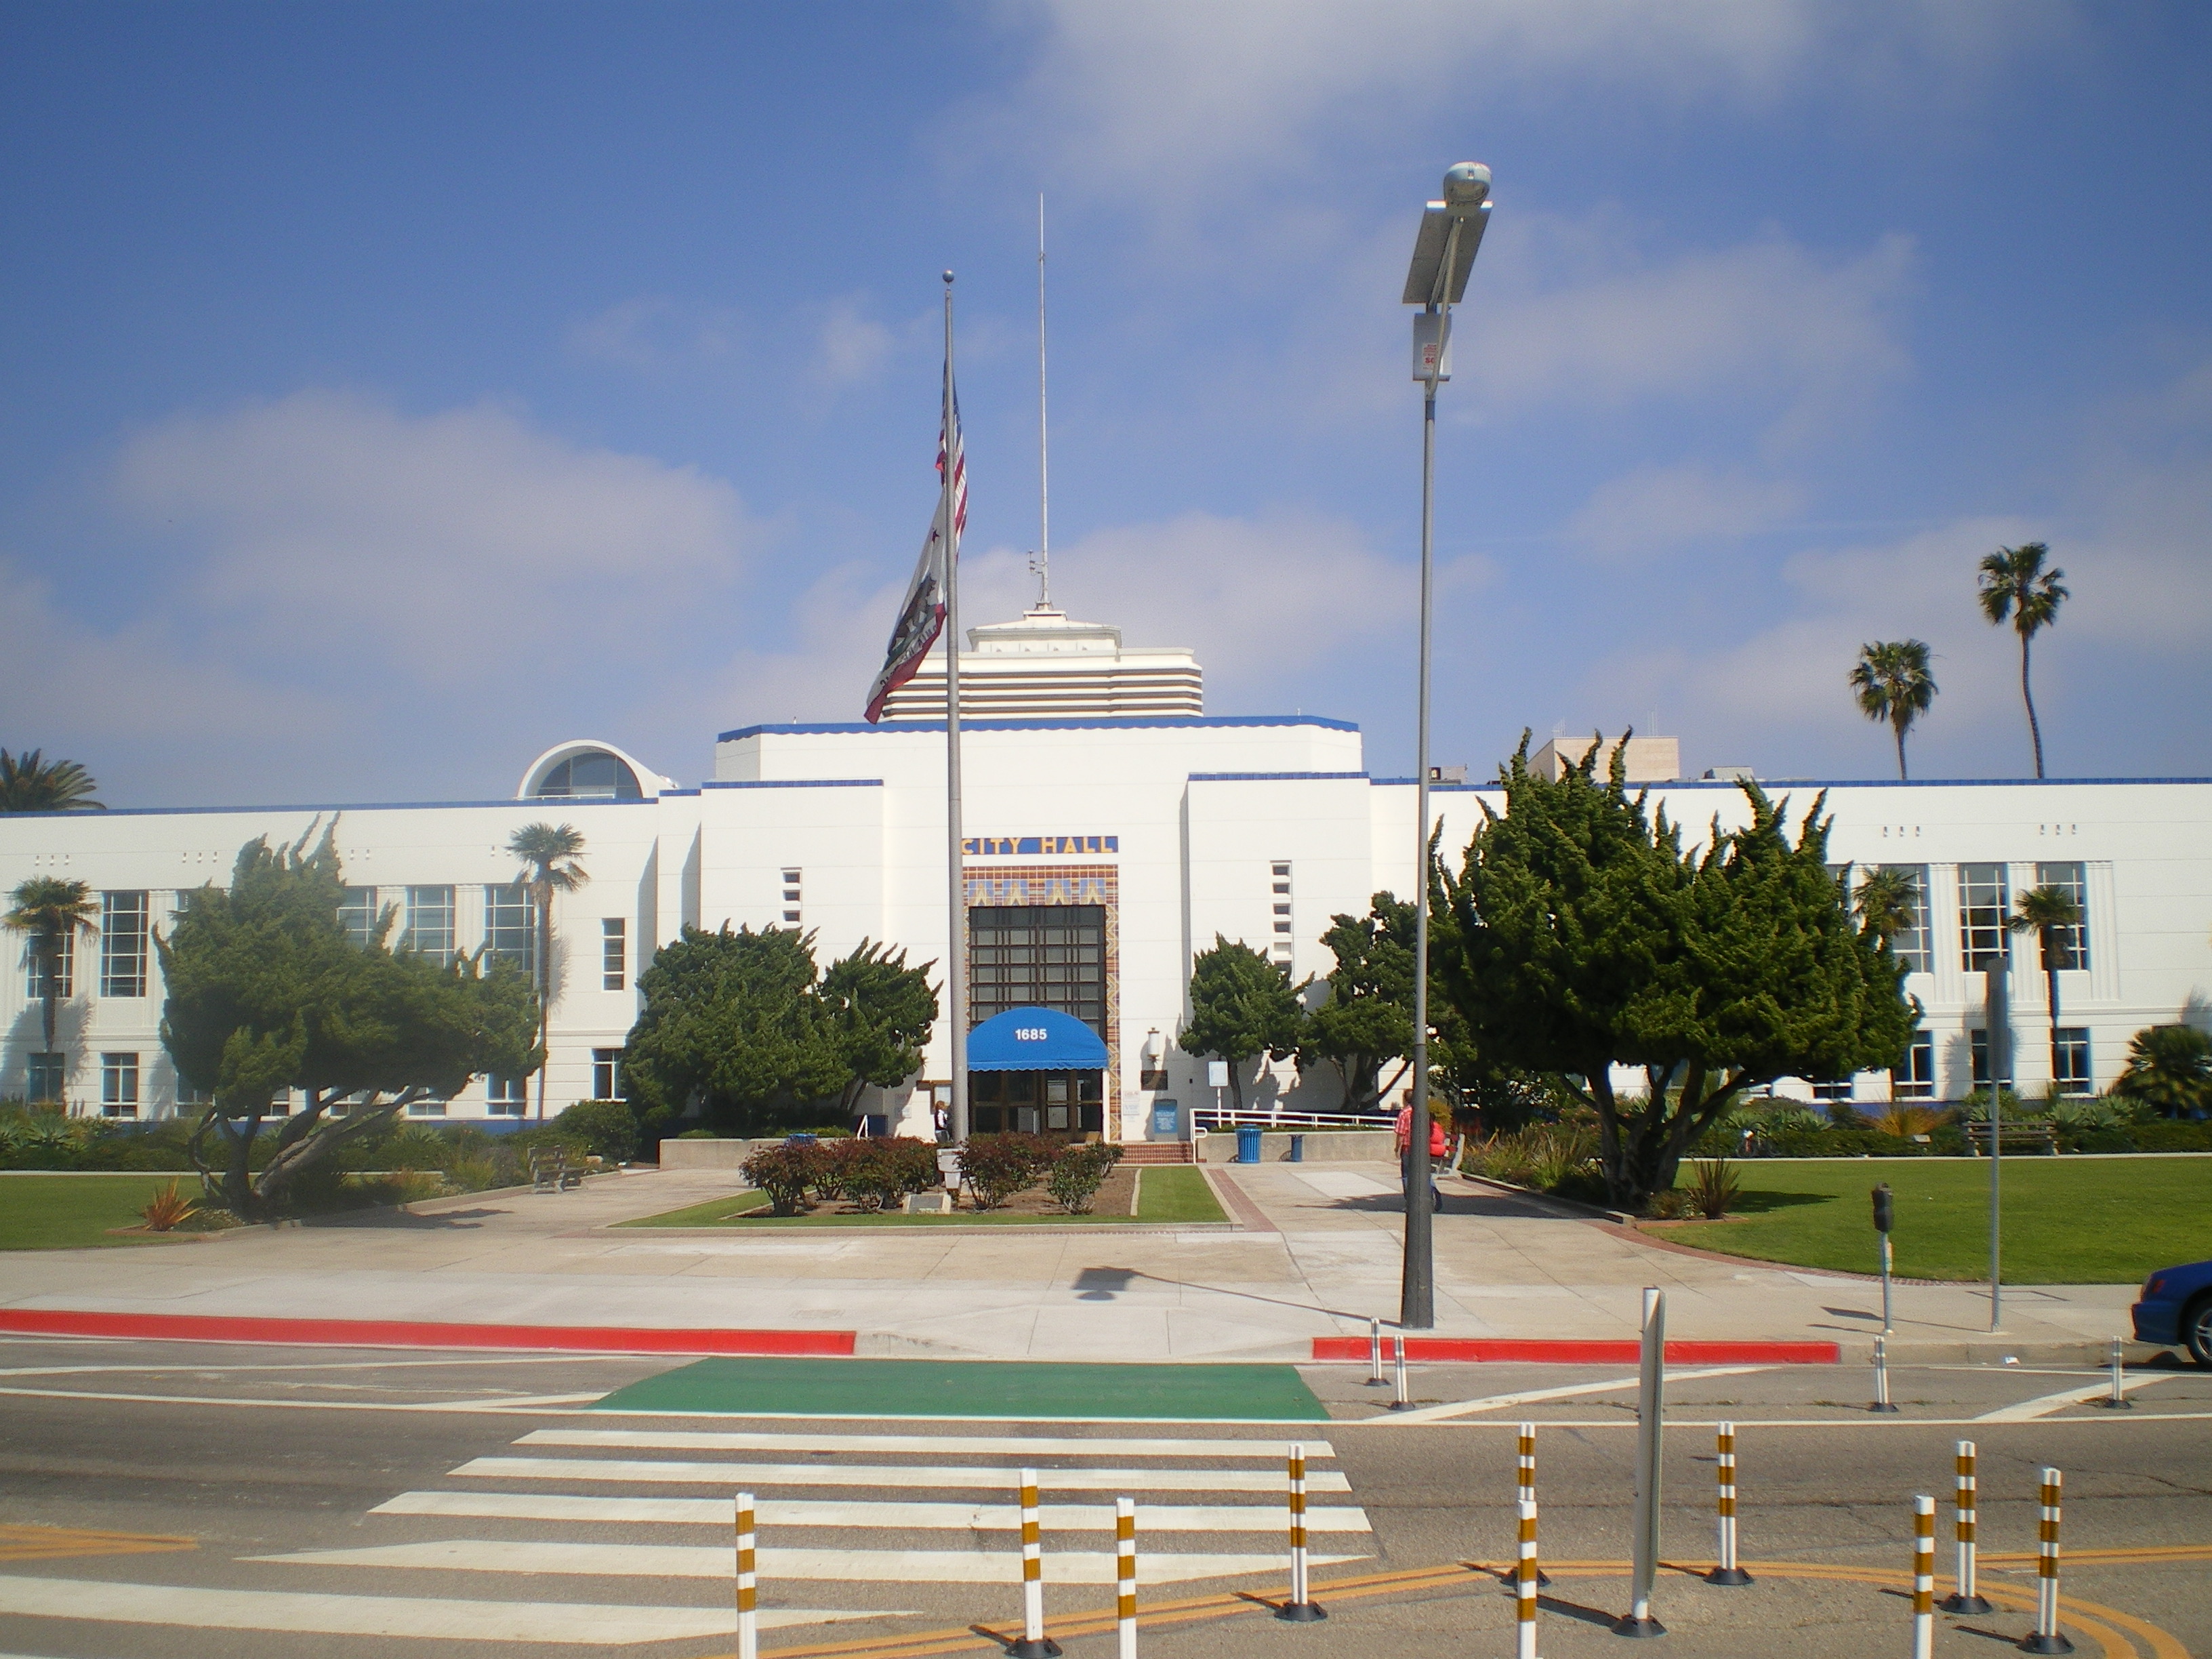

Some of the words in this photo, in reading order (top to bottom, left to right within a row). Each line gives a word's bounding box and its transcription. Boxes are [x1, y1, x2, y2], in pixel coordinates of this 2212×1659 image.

[962, 838, 1022, 855] CITY
[1042, 836, 1113, 854] HALL
[1015, 1028, 1047, 1040] 1685
